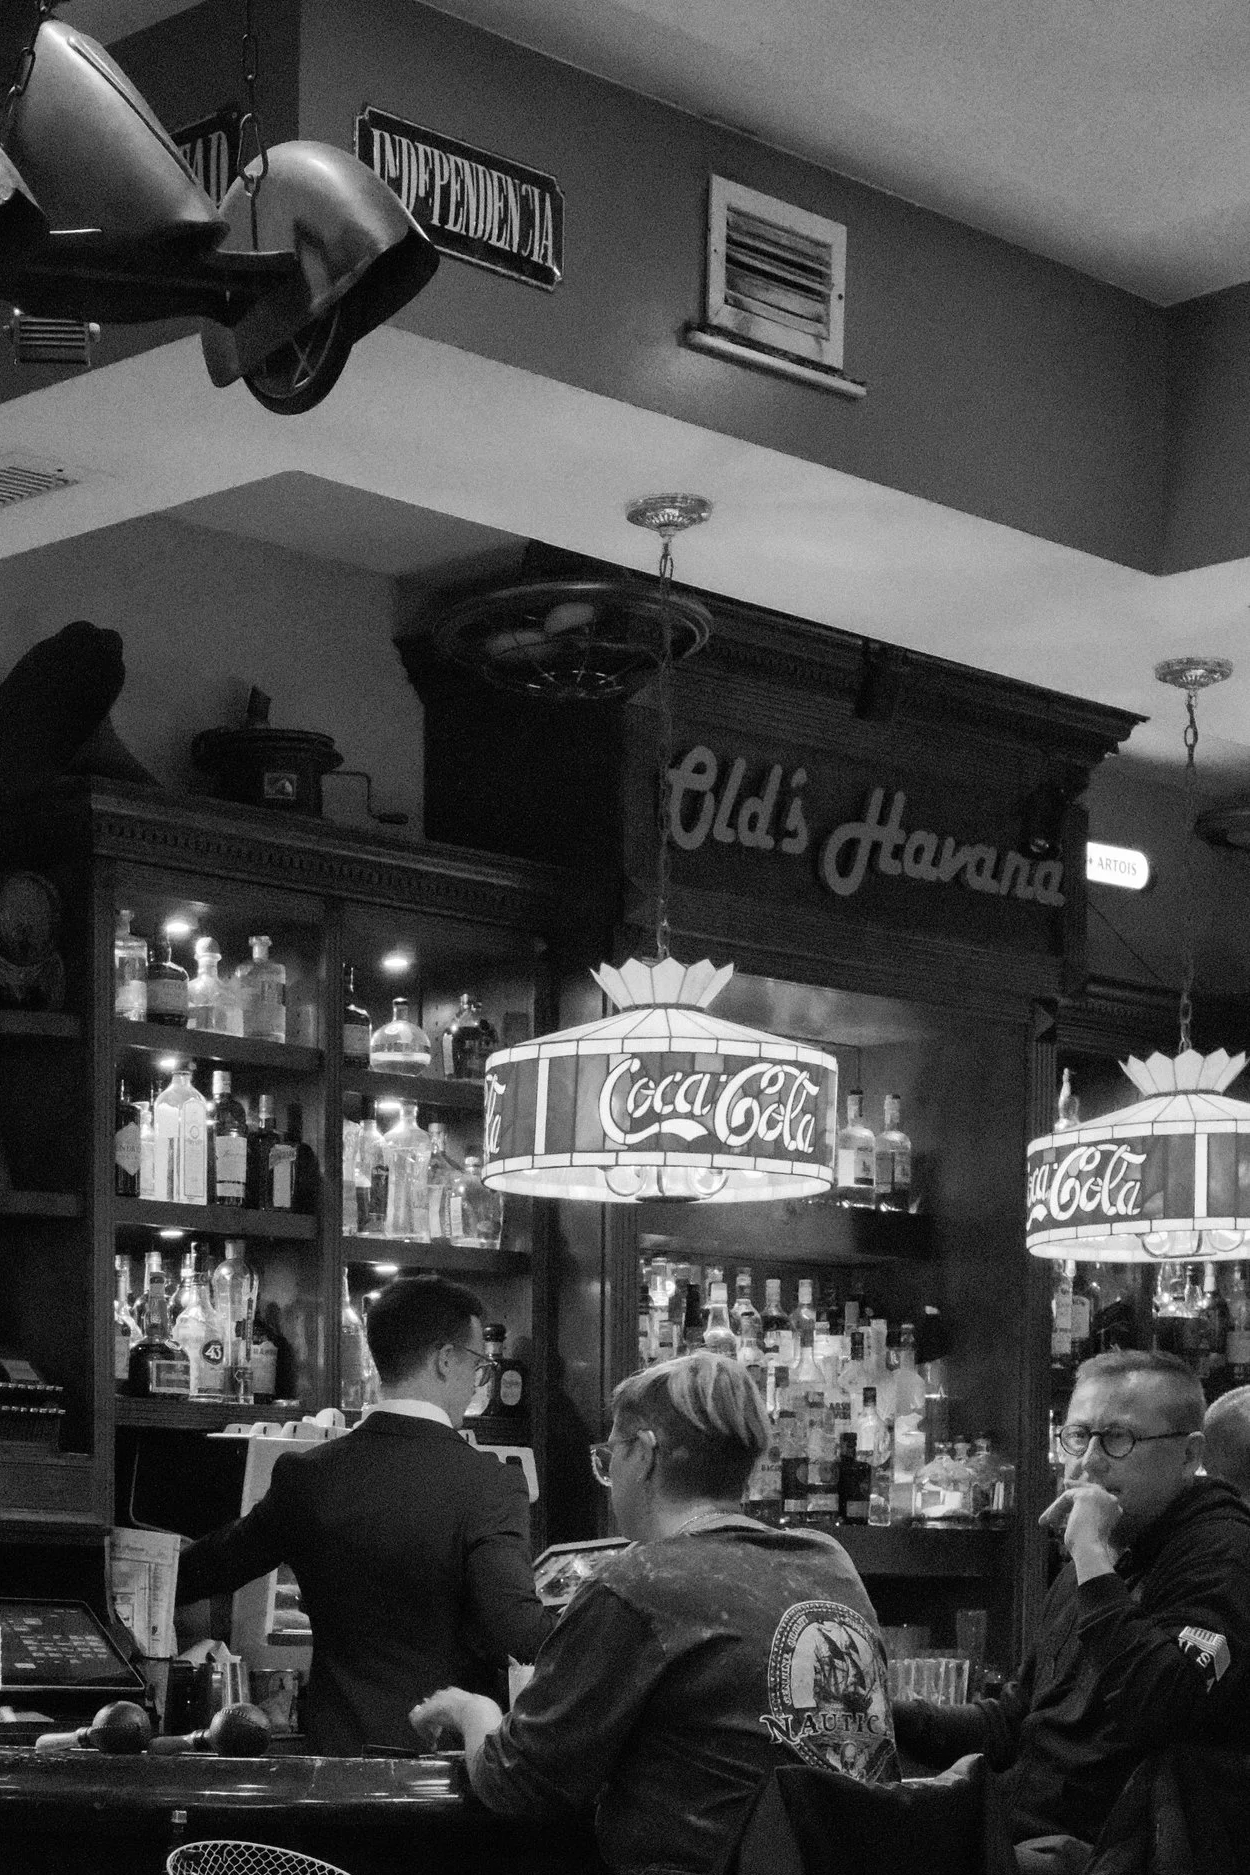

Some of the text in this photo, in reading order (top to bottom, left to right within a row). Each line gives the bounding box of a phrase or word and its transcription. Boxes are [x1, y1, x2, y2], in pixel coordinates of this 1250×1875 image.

[369, 127, 553, 268] INDEPENDENCIA
[667, 745, 1064, 906] Old's Havana
[1098, 857, 1137, 876] ARTOIS
[1027, 1144, 1147, 1230] ca-Cola
[204, 1344, 222, 1360] 43
[759, 1712, 894, 1744] NAUTIC
